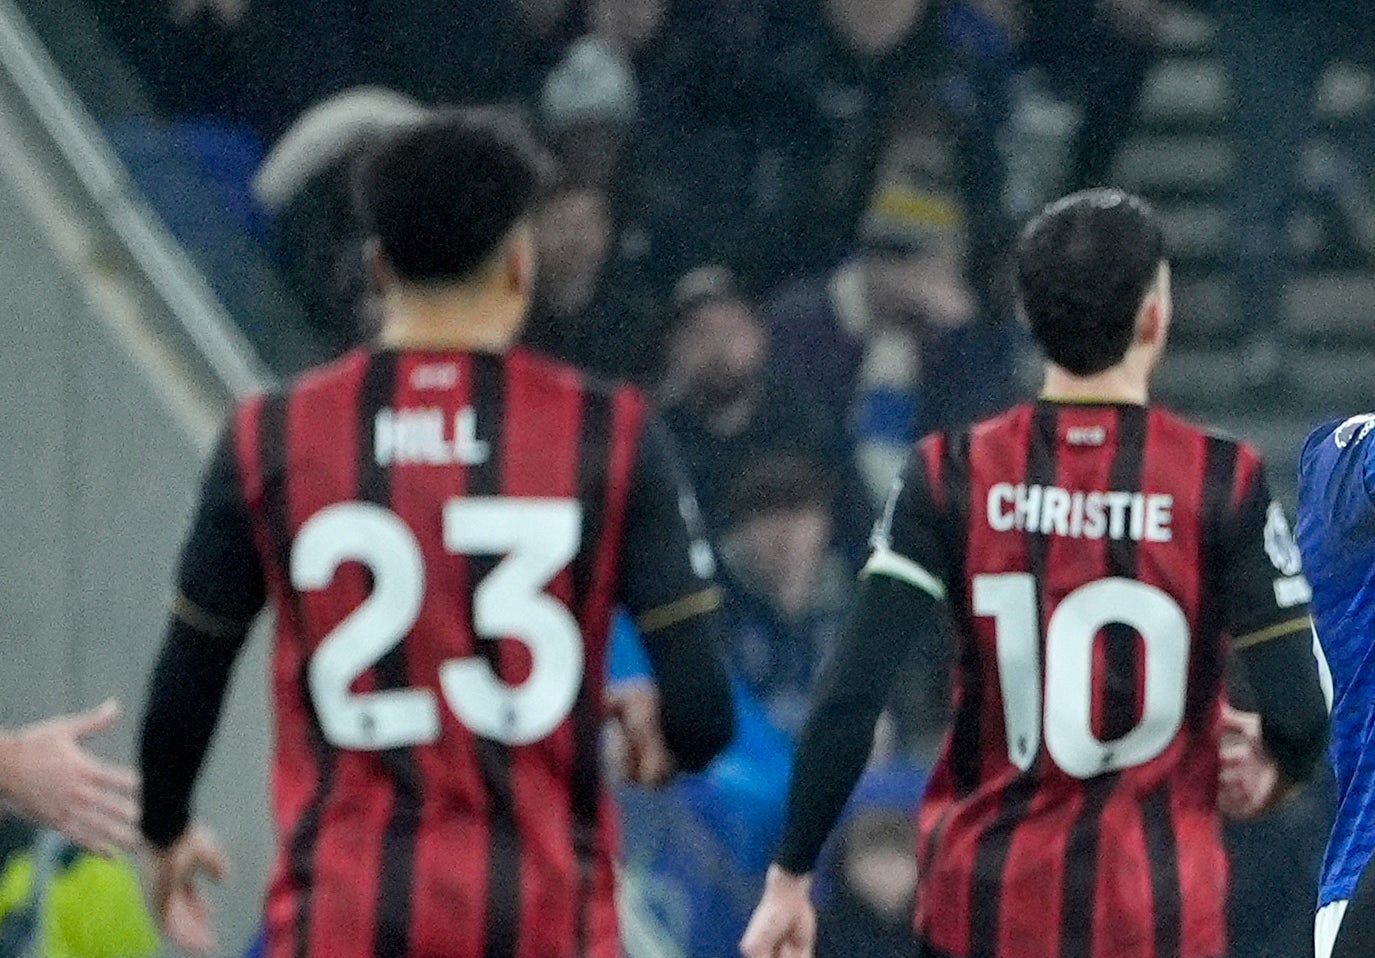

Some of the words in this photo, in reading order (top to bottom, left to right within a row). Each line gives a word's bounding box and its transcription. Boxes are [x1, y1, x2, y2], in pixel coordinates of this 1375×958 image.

[987, 482, 1174, 542] CHRISTIE
[290, 497, 586, 750] 23
[972, 570, 1191, 780] 10
